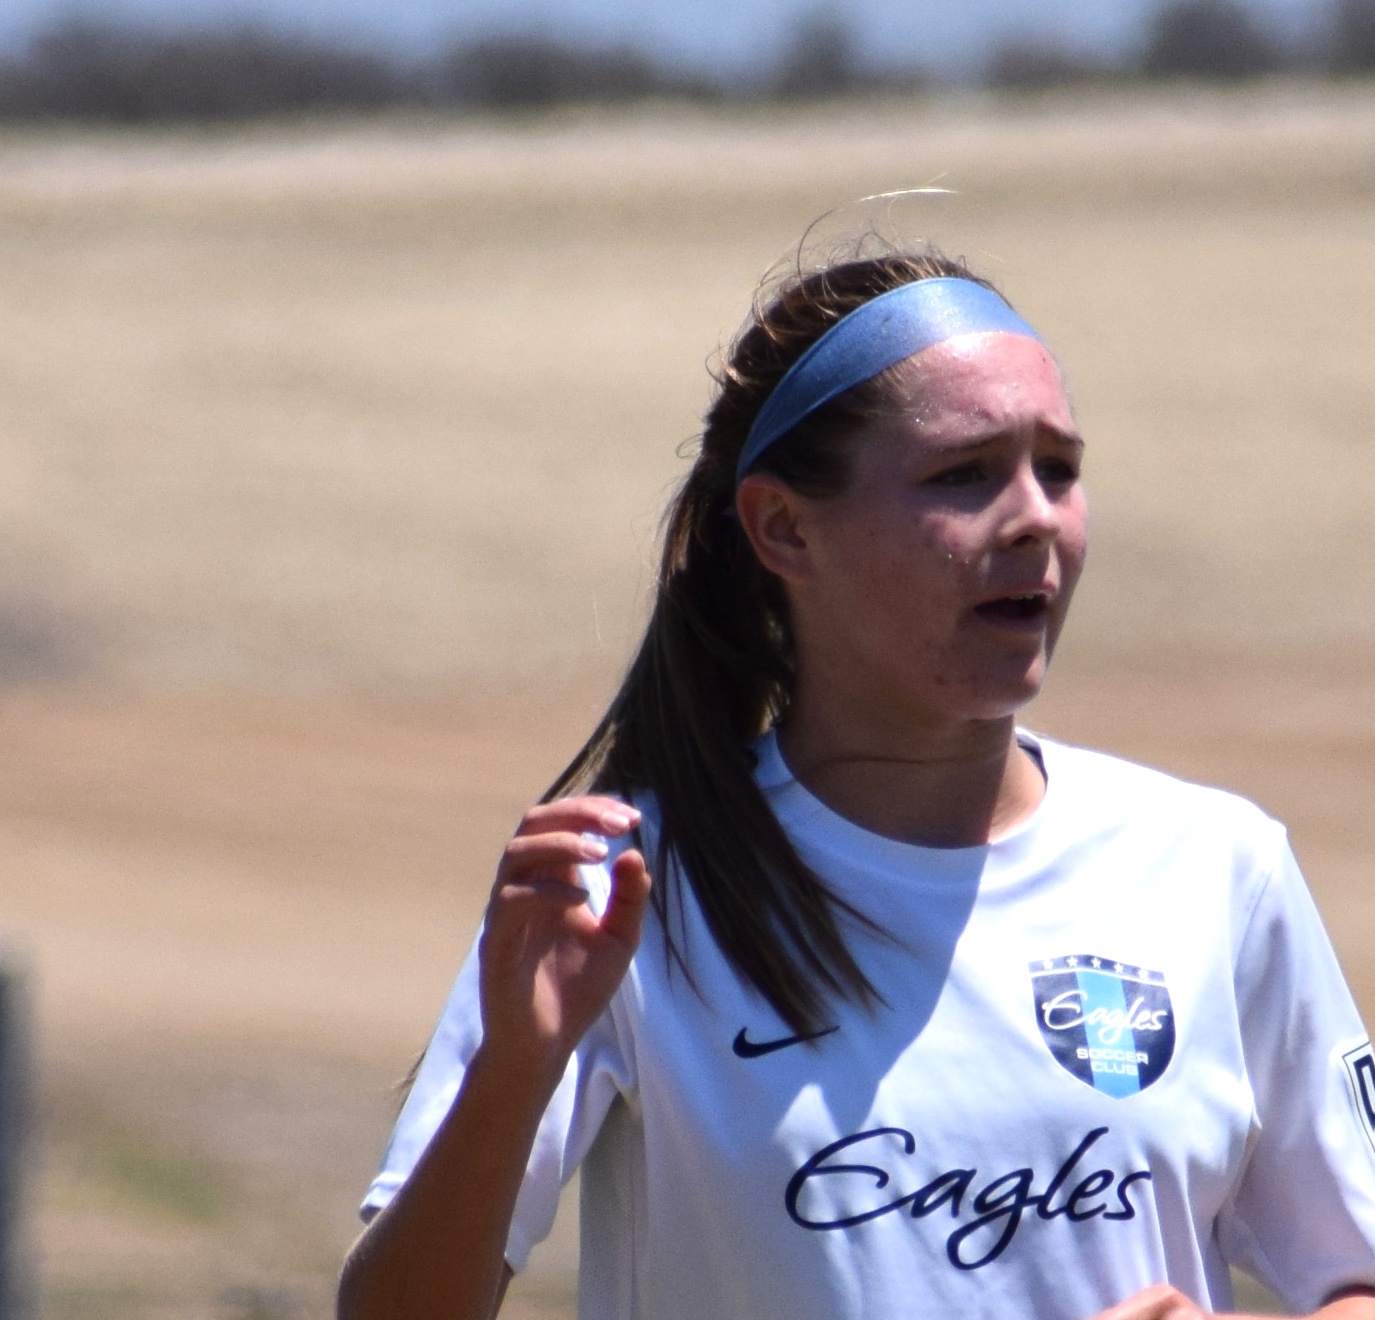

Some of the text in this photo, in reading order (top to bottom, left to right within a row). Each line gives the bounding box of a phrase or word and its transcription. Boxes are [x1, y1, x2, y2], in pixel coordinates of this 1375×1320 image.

[1042, 990, 1168, 1045] Eagles
[1076, 1048, 1149, 1065] SOCCER
[1092, 1061, 1138, 1076] CLUB
[785, 1127, 1152, 1270] Eagles
